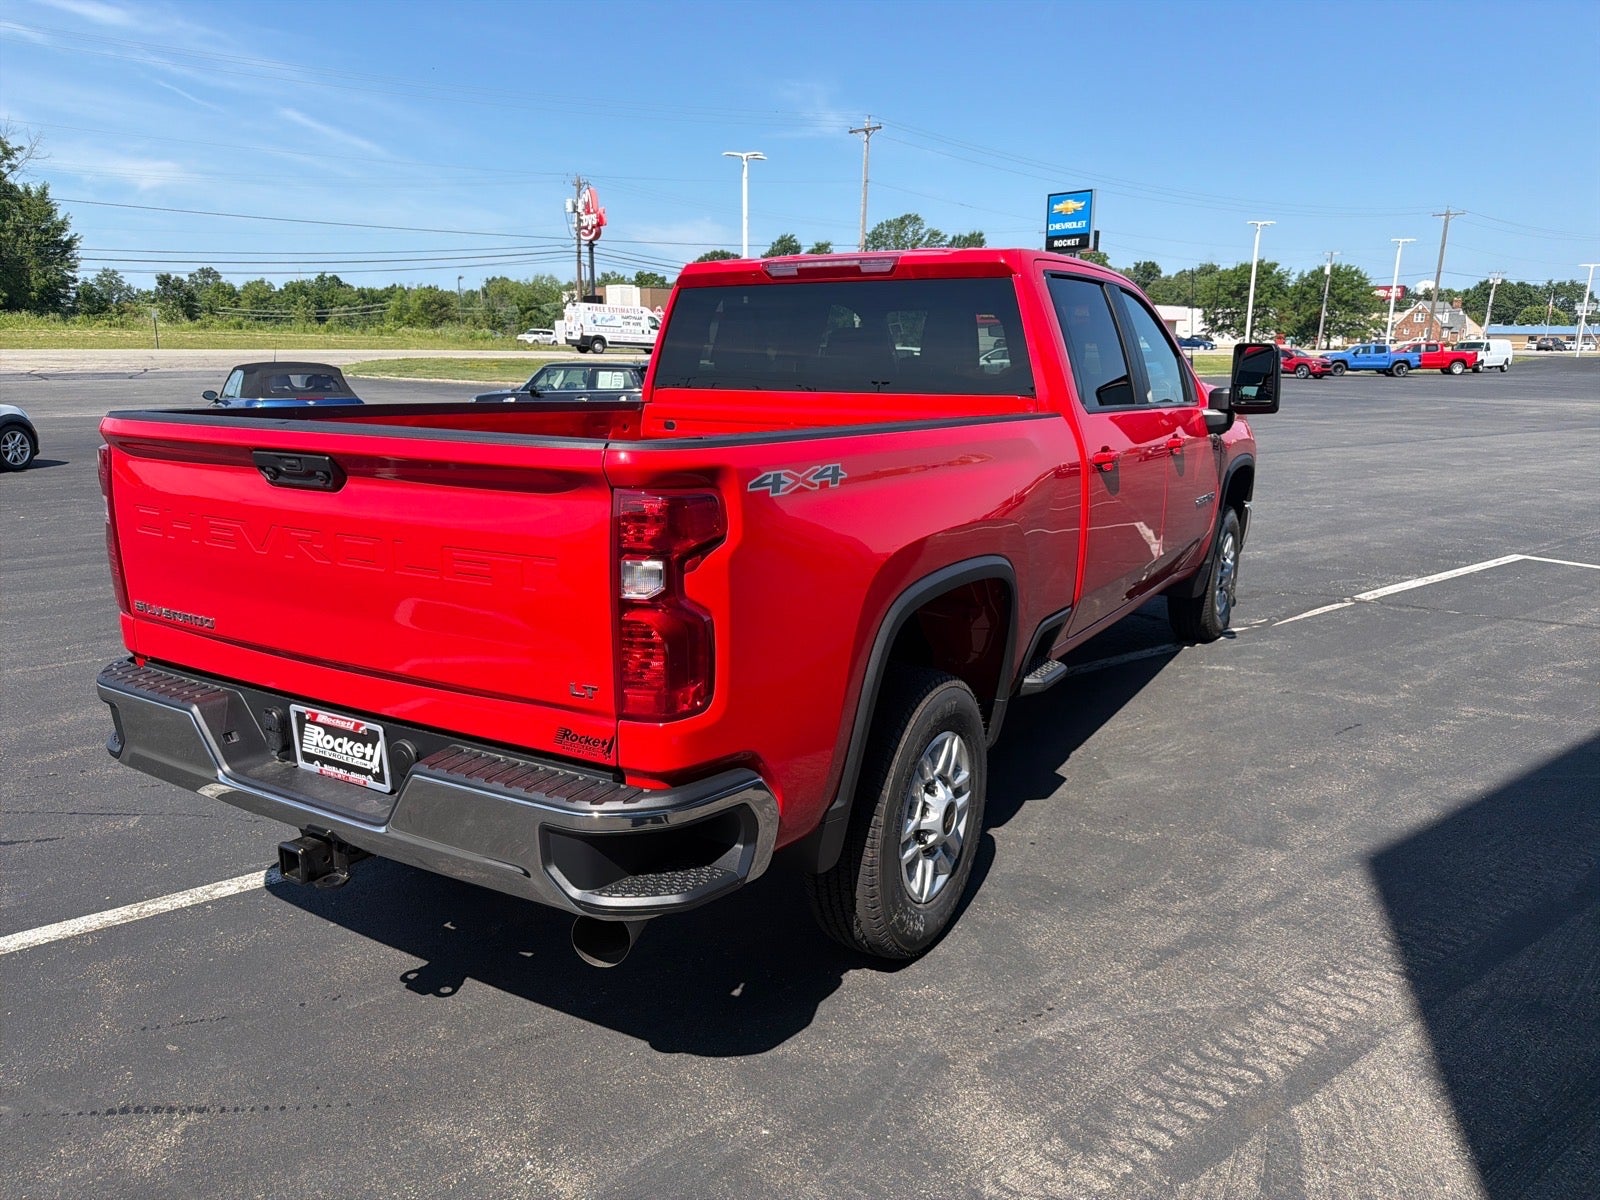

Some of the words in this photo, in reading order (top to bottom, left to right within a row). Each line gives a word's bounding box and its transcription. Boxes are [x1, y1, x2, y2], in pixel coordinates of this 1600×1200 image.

[1048, 220, 1087, 231] CHEVROLET
[1053, 238, 1080, 248] ROCKET
[608, 306, 640, 314] ESTIMATES
[135, 505, 557, 591] CHEVROLET
[134, 600, 215, 630] SILVERADO
[569, 682, 599, 699] LT
[313, 747, 368, 768] CHEVROLET.COM
